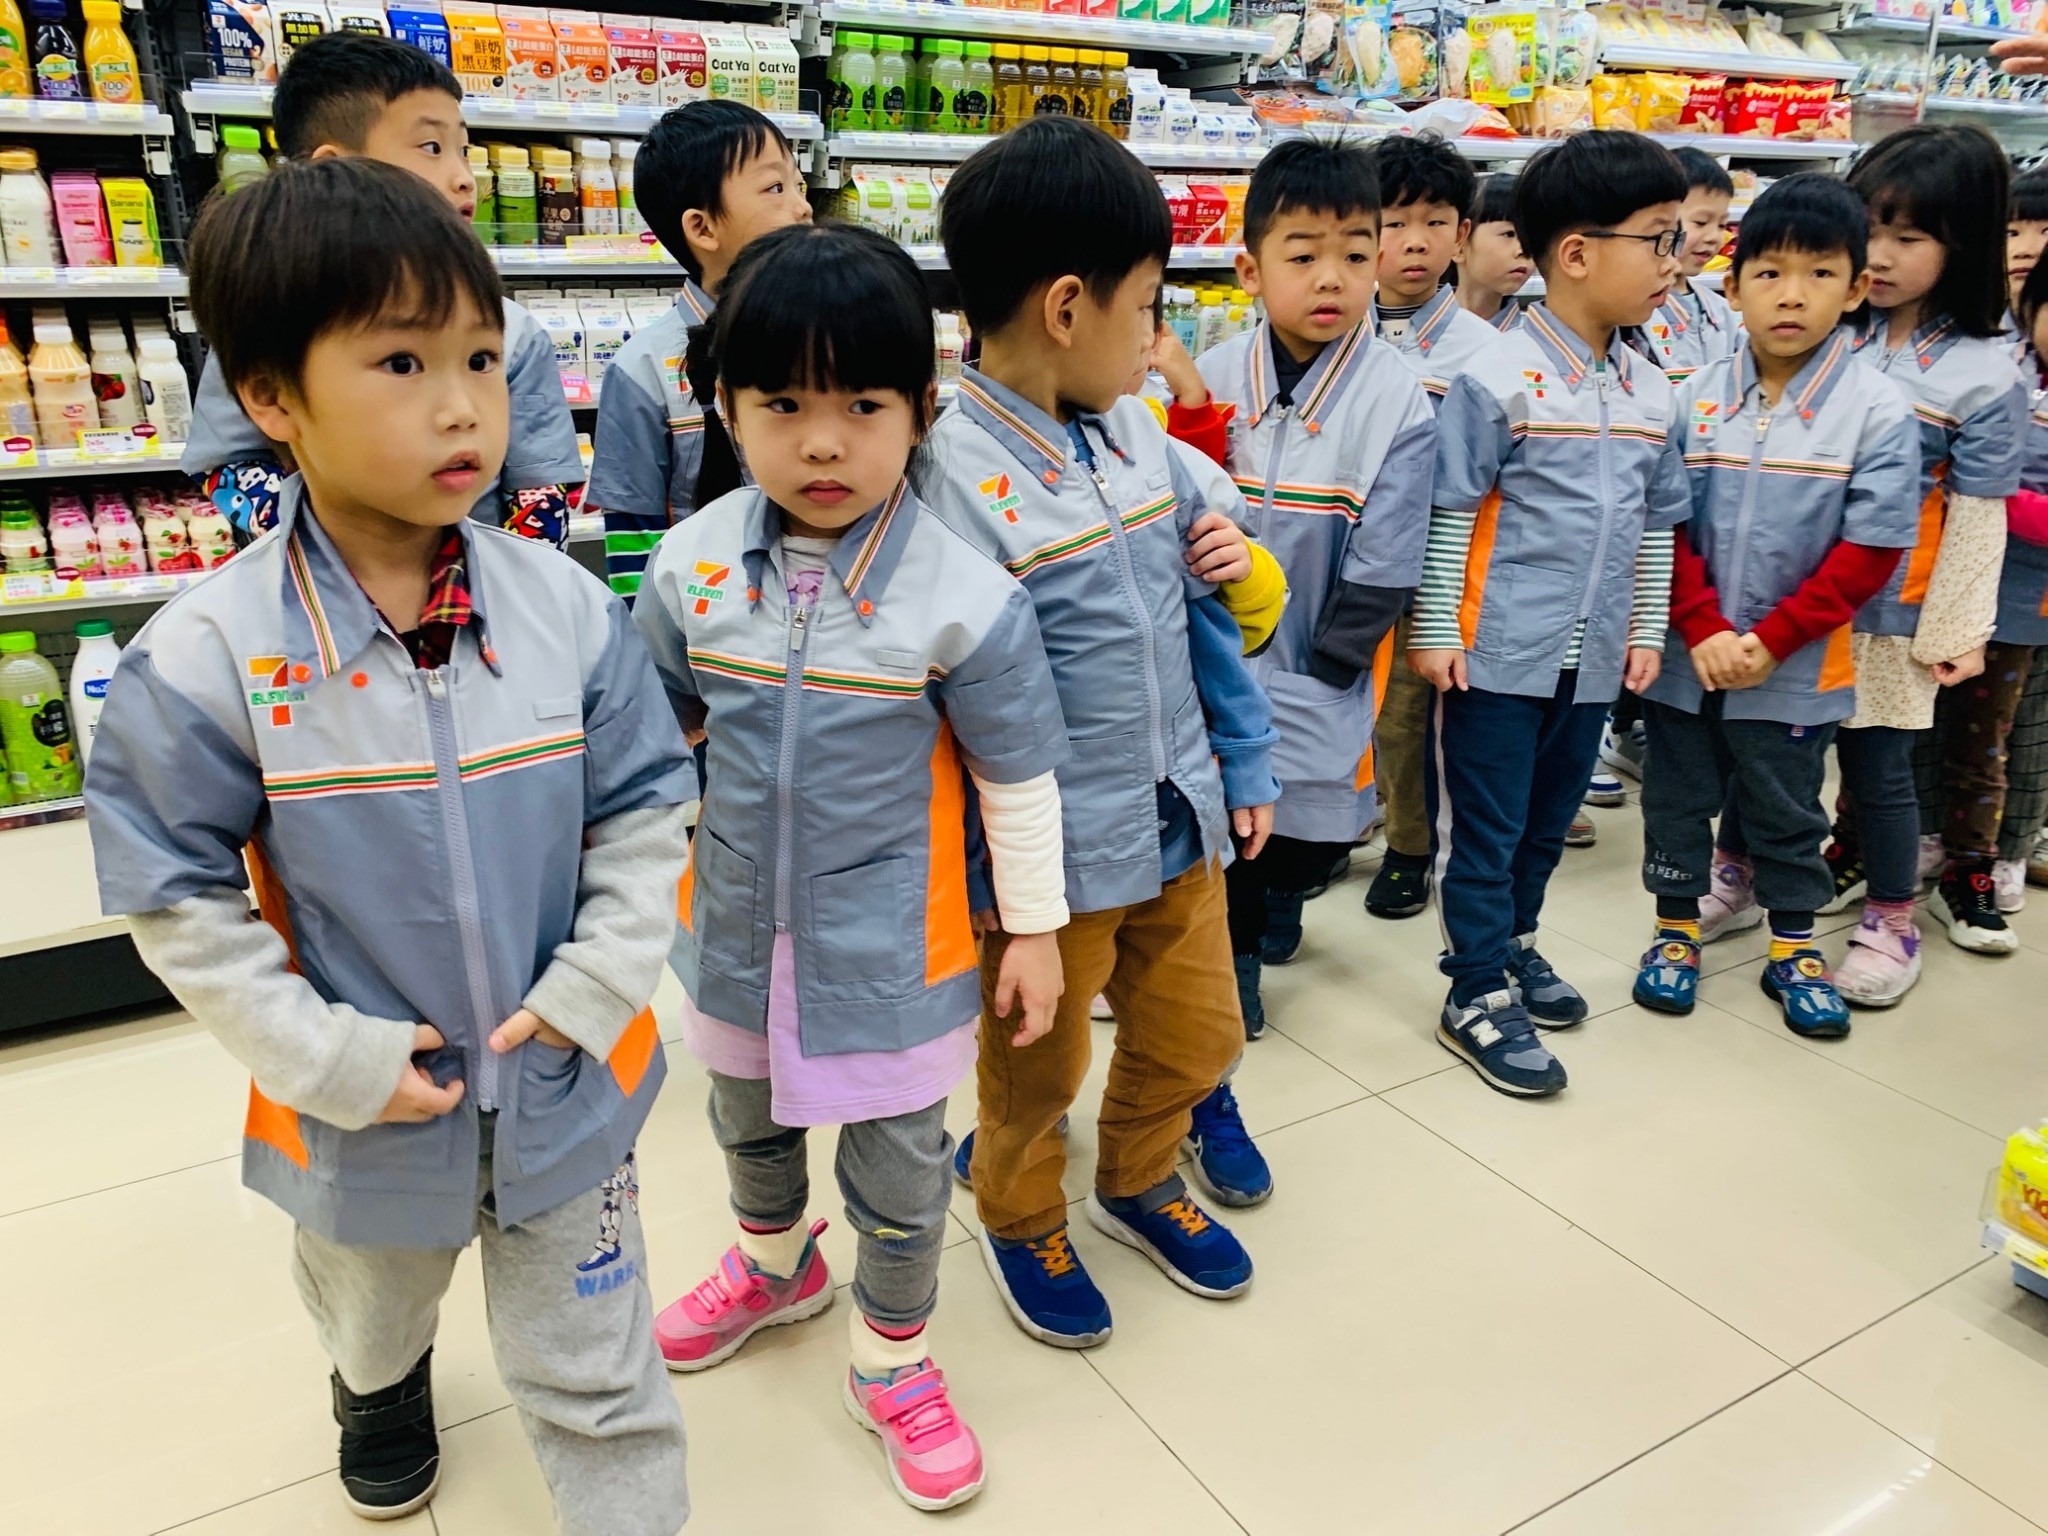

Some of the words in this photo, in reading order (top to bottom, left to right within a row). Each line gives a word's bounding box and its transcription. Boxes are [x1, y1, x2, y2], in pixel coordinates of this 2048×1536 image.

[217, 28, 253, 48] 100%
[417, 35, 447, 52] 鮮奶
[474, 38, 501, 54] 鮮奶
[462, 55, 502, 71] 黑豆漿
[735, 60, 750, 71] Ya
[782, 63, 796, 74] Ya
[102, 81, 123, 90] 100
[110, 199, 144, 207] Banana
[977, 472, 1020, 524] 7
[693, 559, 732, 616] 7
[247, 656, 293, 727] 7
